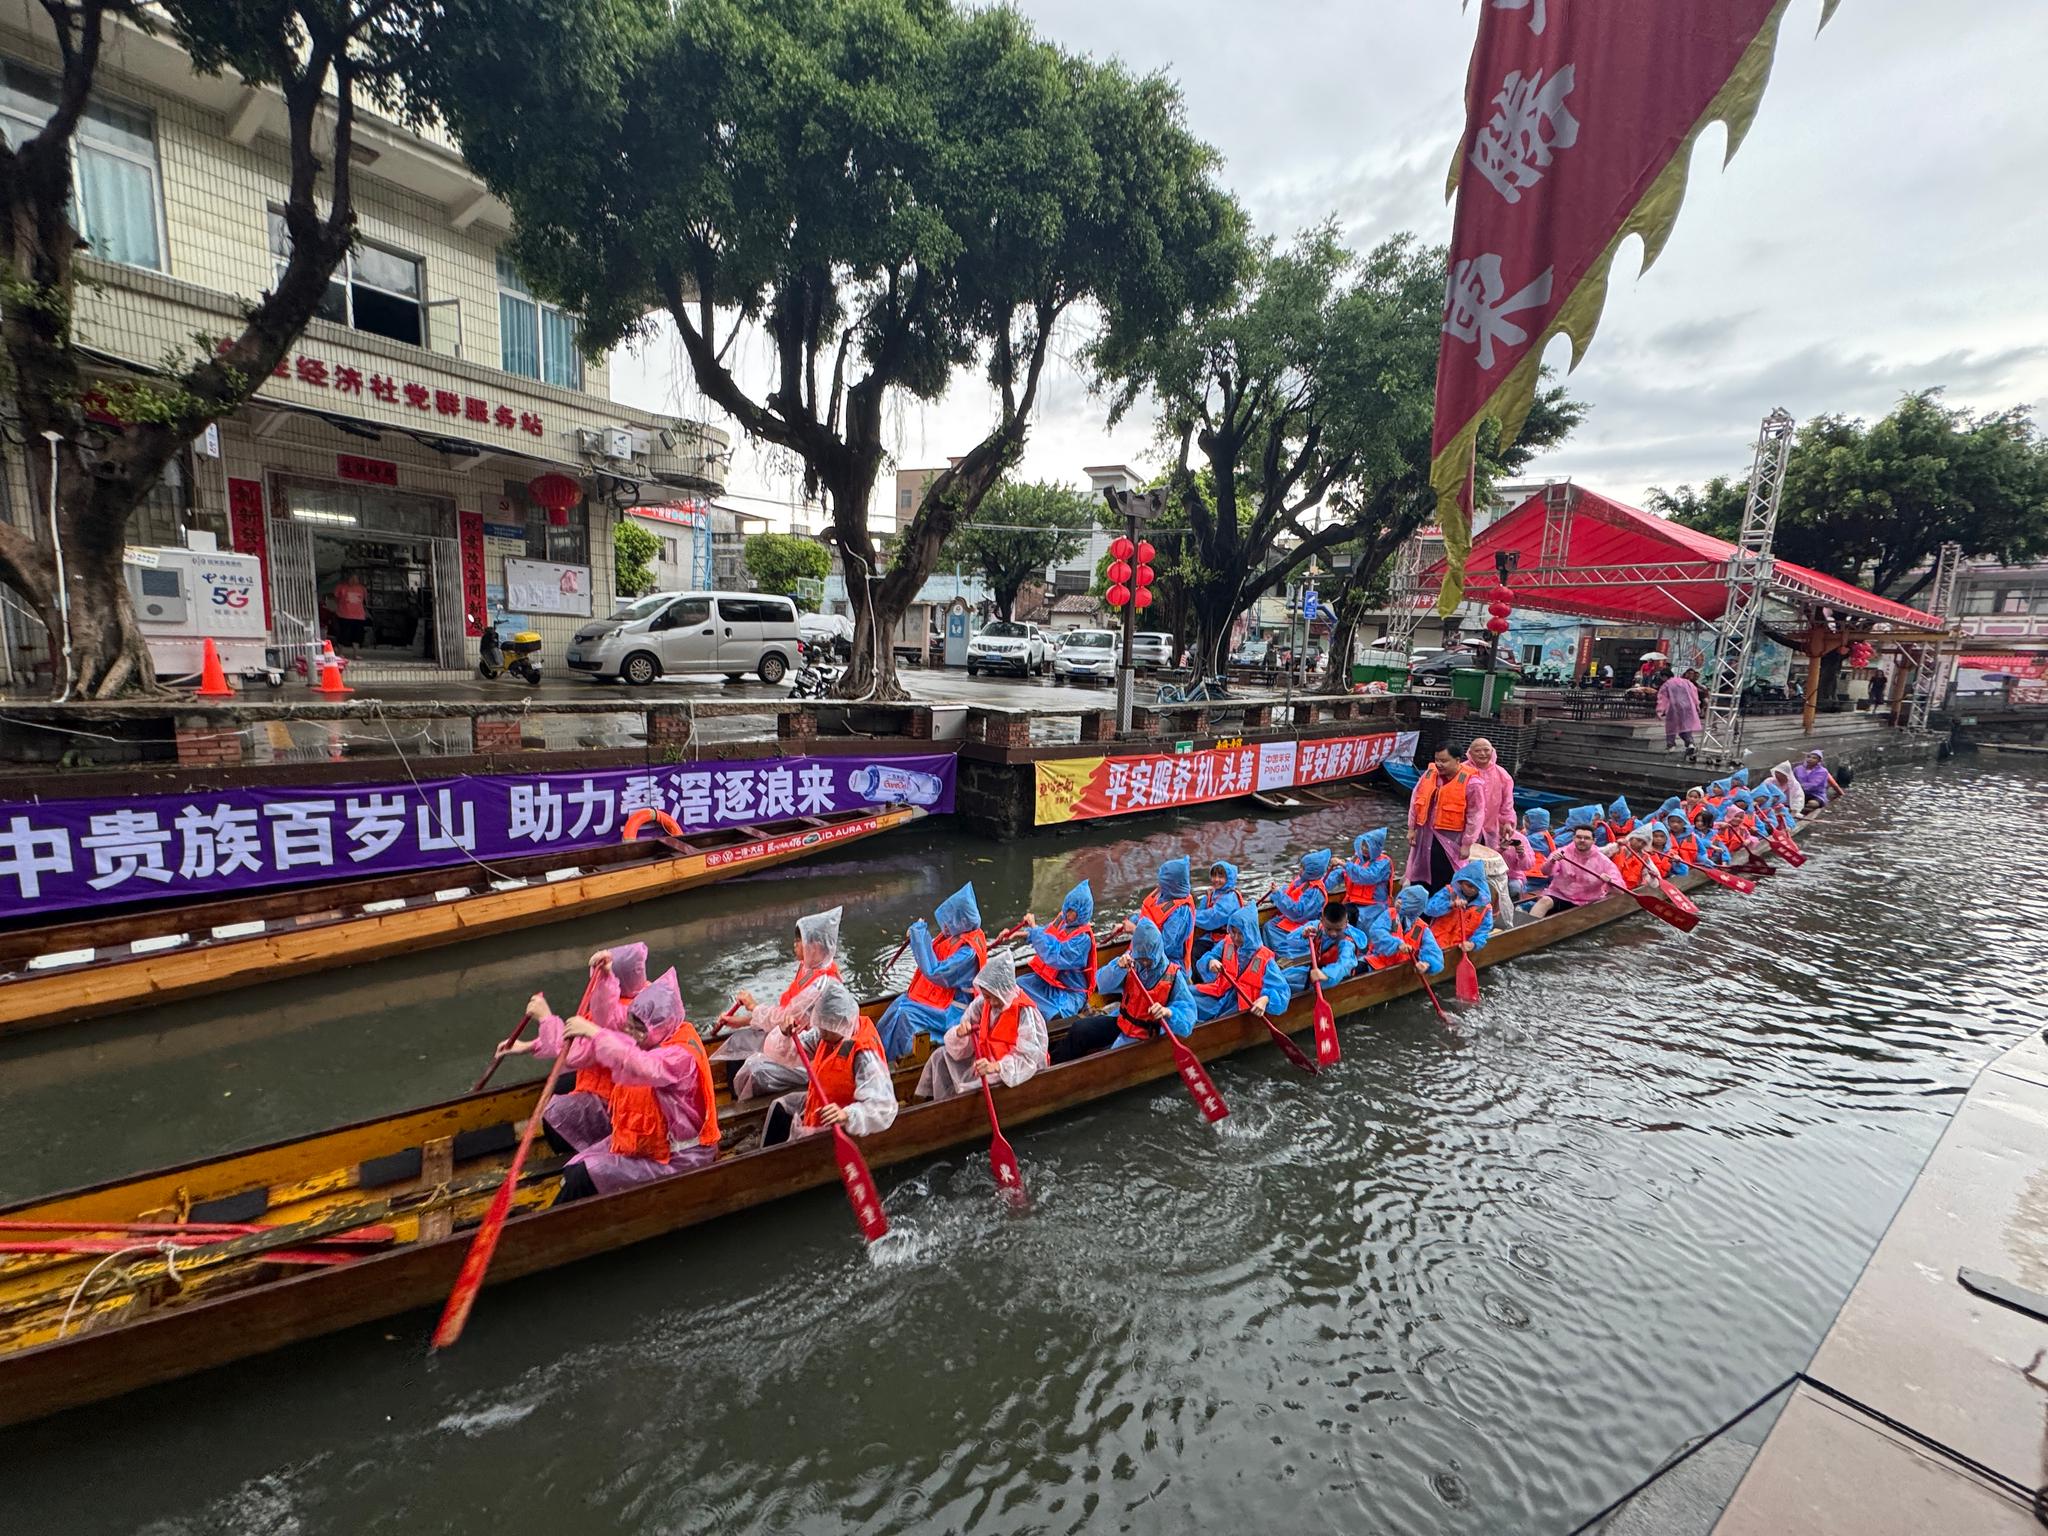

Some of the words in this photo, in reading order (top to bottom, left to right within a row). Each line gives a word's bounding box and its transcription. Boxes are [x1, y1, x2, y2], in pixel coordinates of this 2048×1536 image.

[211, 587, 250, 608] 5G
[835, 825, 862, 838] AURA
[864, 820, 877, 831] T6
[0, 788, 476, 898] 中贵族百岁山
